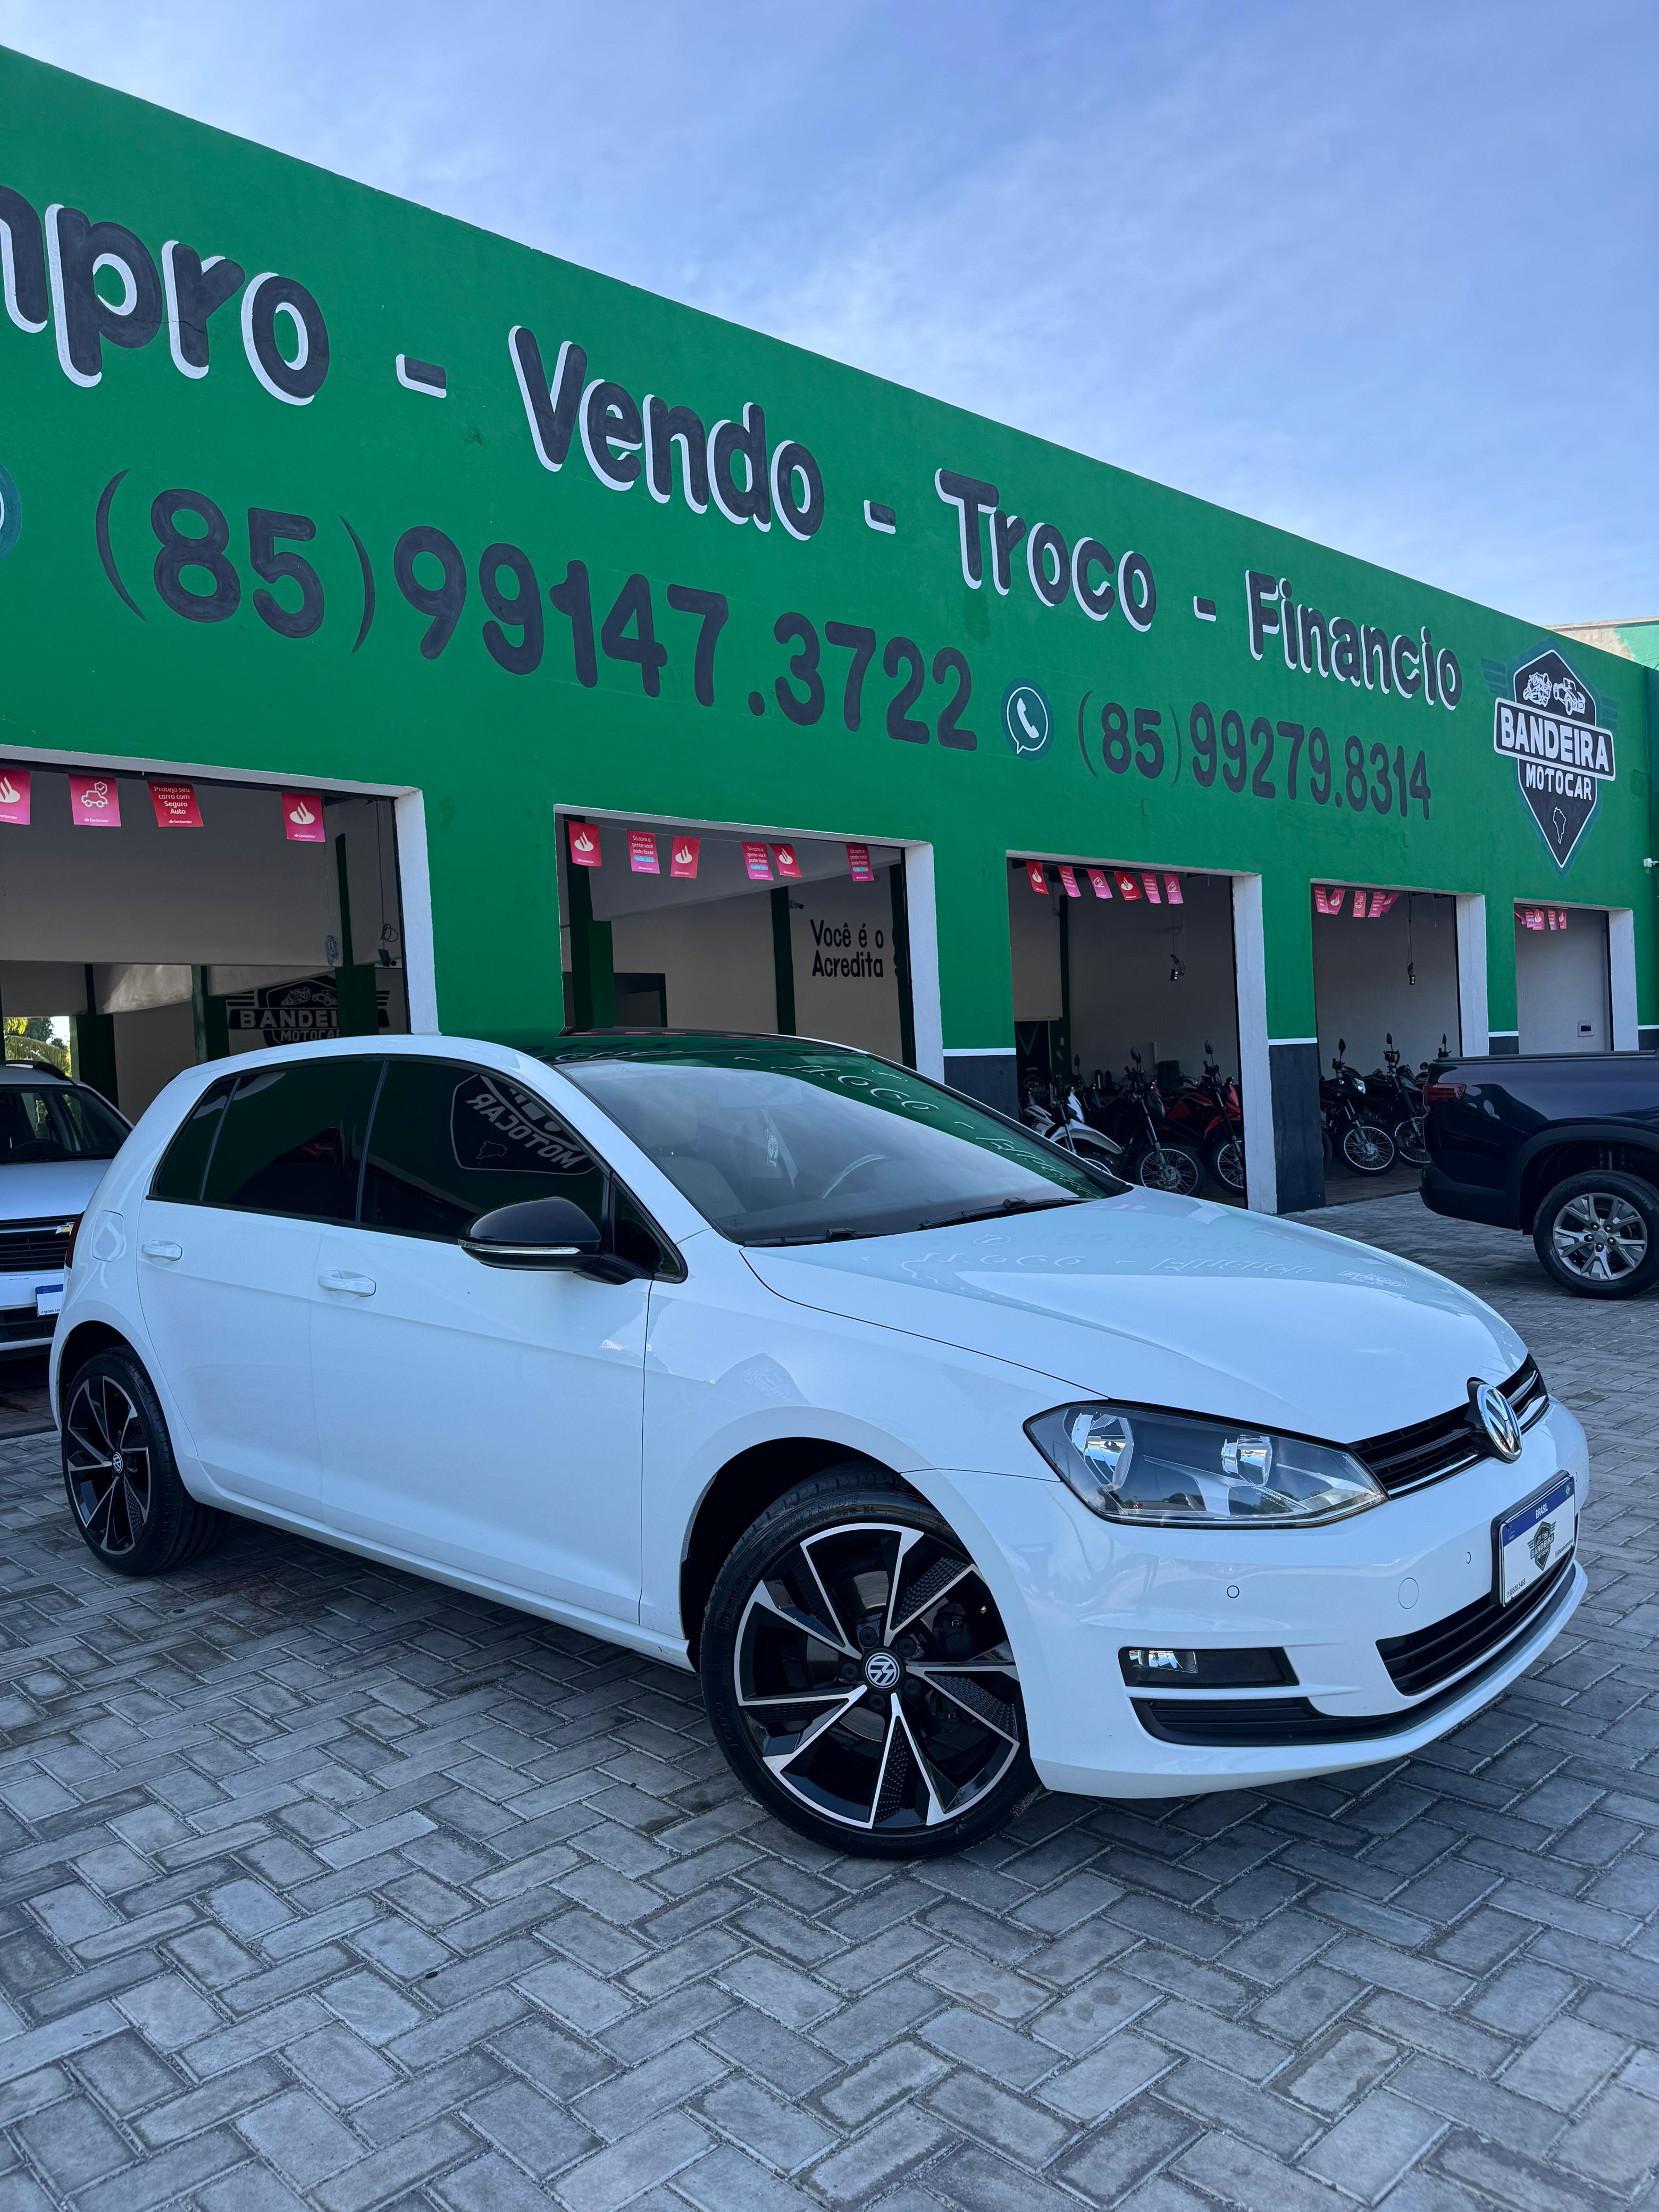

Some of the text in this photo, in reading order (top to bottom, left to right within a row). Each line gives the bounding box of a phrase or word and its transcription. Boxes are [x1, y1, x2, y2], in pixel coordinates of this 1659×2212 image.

[508, 325, 825, 541] Vendo
[934, 468, 1157, 633] Troco
[1244, 569, 1463, 711] Financio
[1501, 707, 1610, 773] BANDEIRA
[1525, 764, 1593, 801] MOTOCAR
[810, 919, 884, 949] Você é o
[811, 949, 884, 978] Acredita
[239, 1010, 338, 1028] BANDEI
[1535, 1503, 1548, 1519] BRASIL
